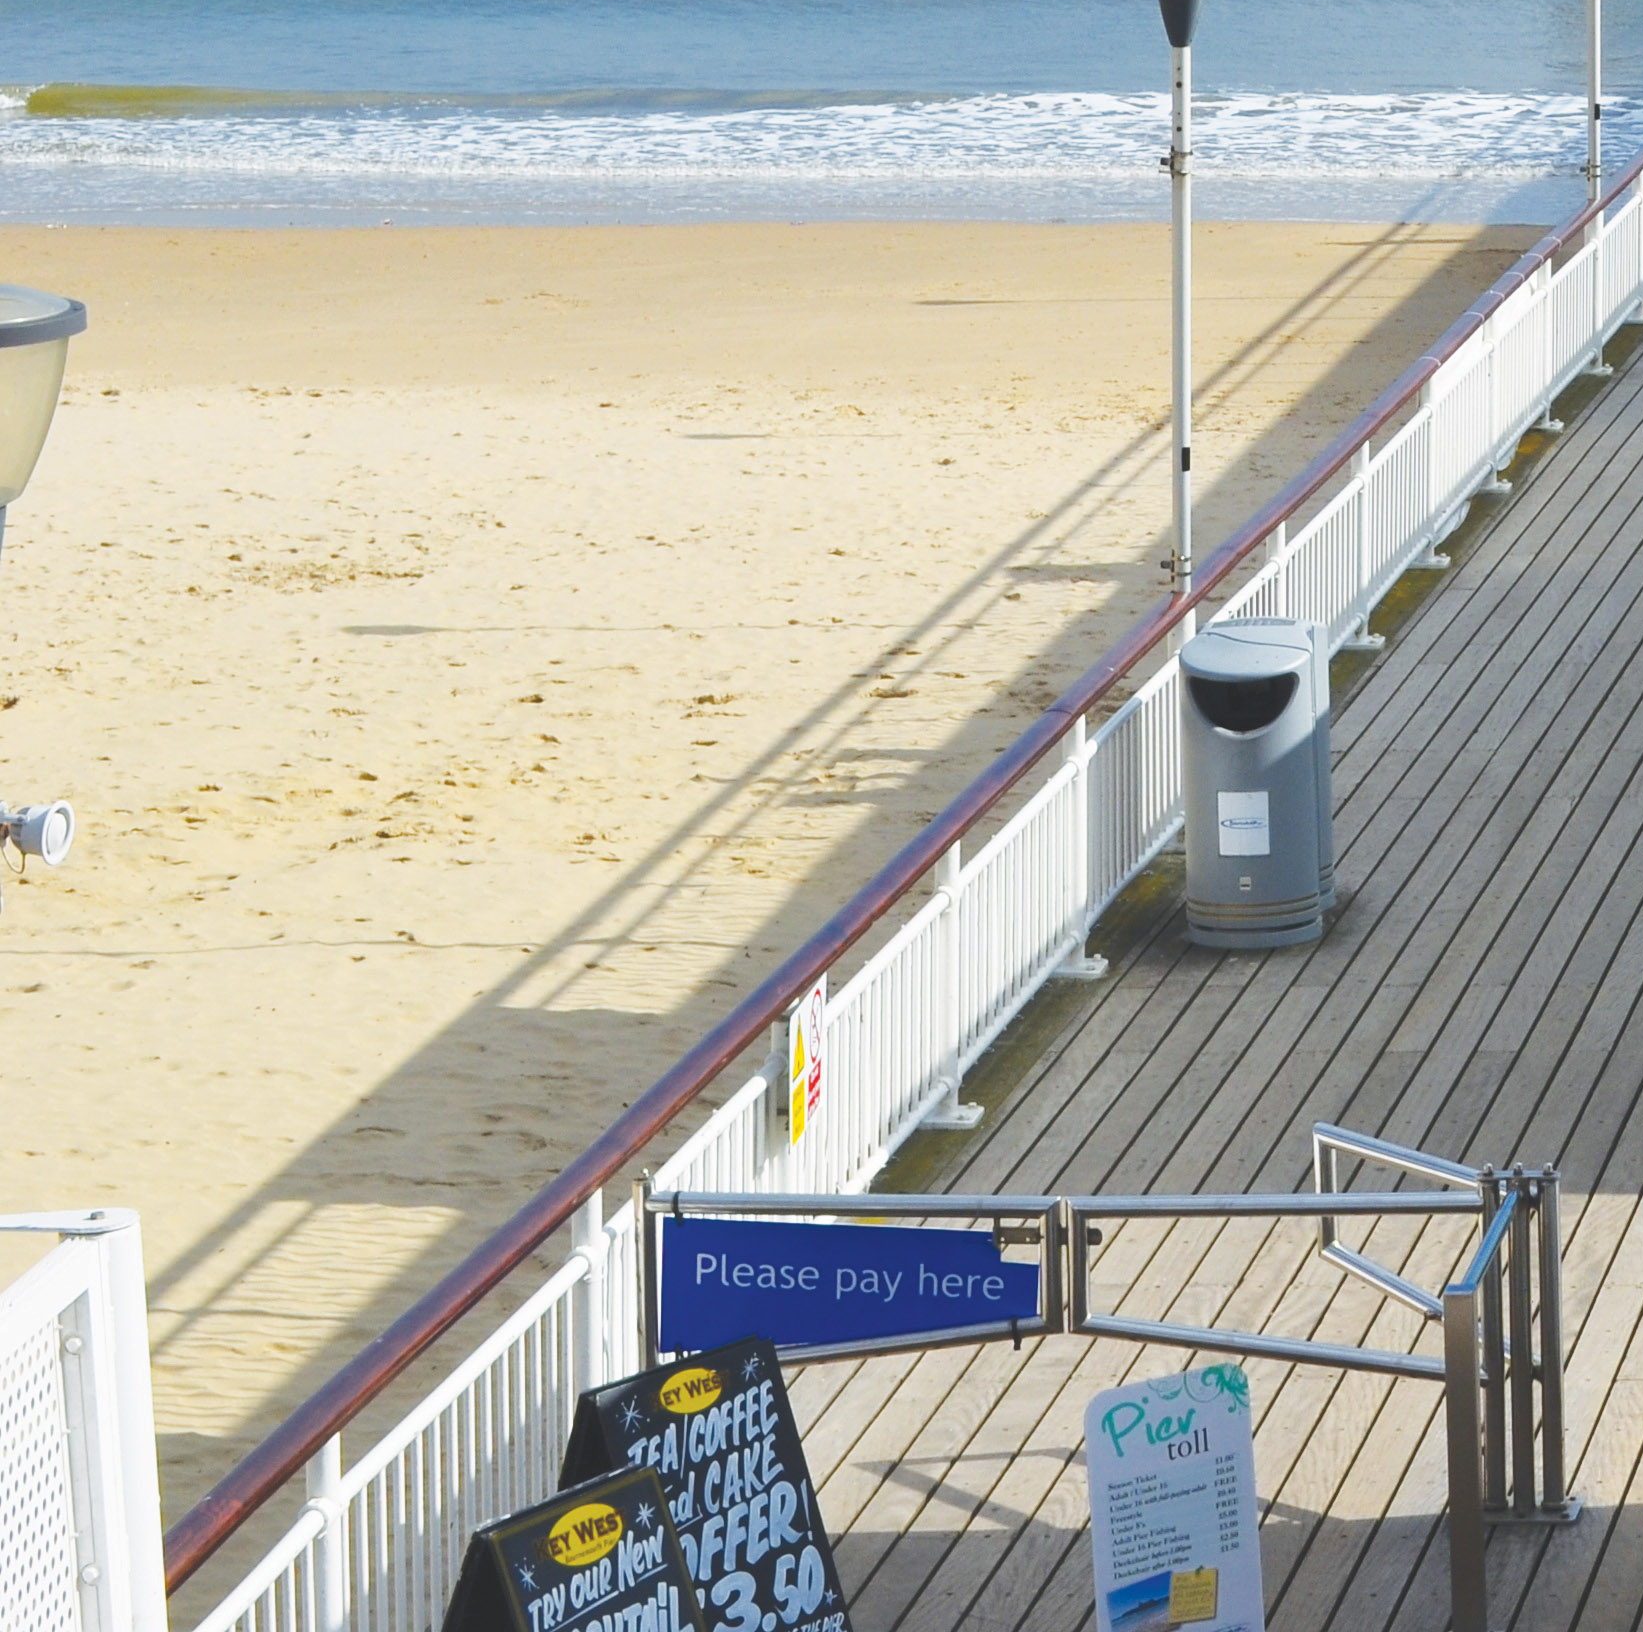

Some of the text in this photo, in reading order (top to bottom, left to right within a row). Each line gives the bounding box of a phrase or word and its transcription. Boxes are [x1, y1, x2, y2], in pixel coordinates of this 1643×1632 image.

[696, 1252, 1005, 1302] Please pay here
[1102, 1396, 1196, 1457] Pier
[1167, 1427, 1209, 1461] toll
[704, 1432, 784, 1514] CAKE
[1214, 1475, 1238, 1488] FREE
[1215, 1497, 1239, 1509] FREE
[528, 1583, 565, 1632] TRY
[570, 1558, 612, 1609] OUR
[696, 1545, 825, 1632] 3.50
